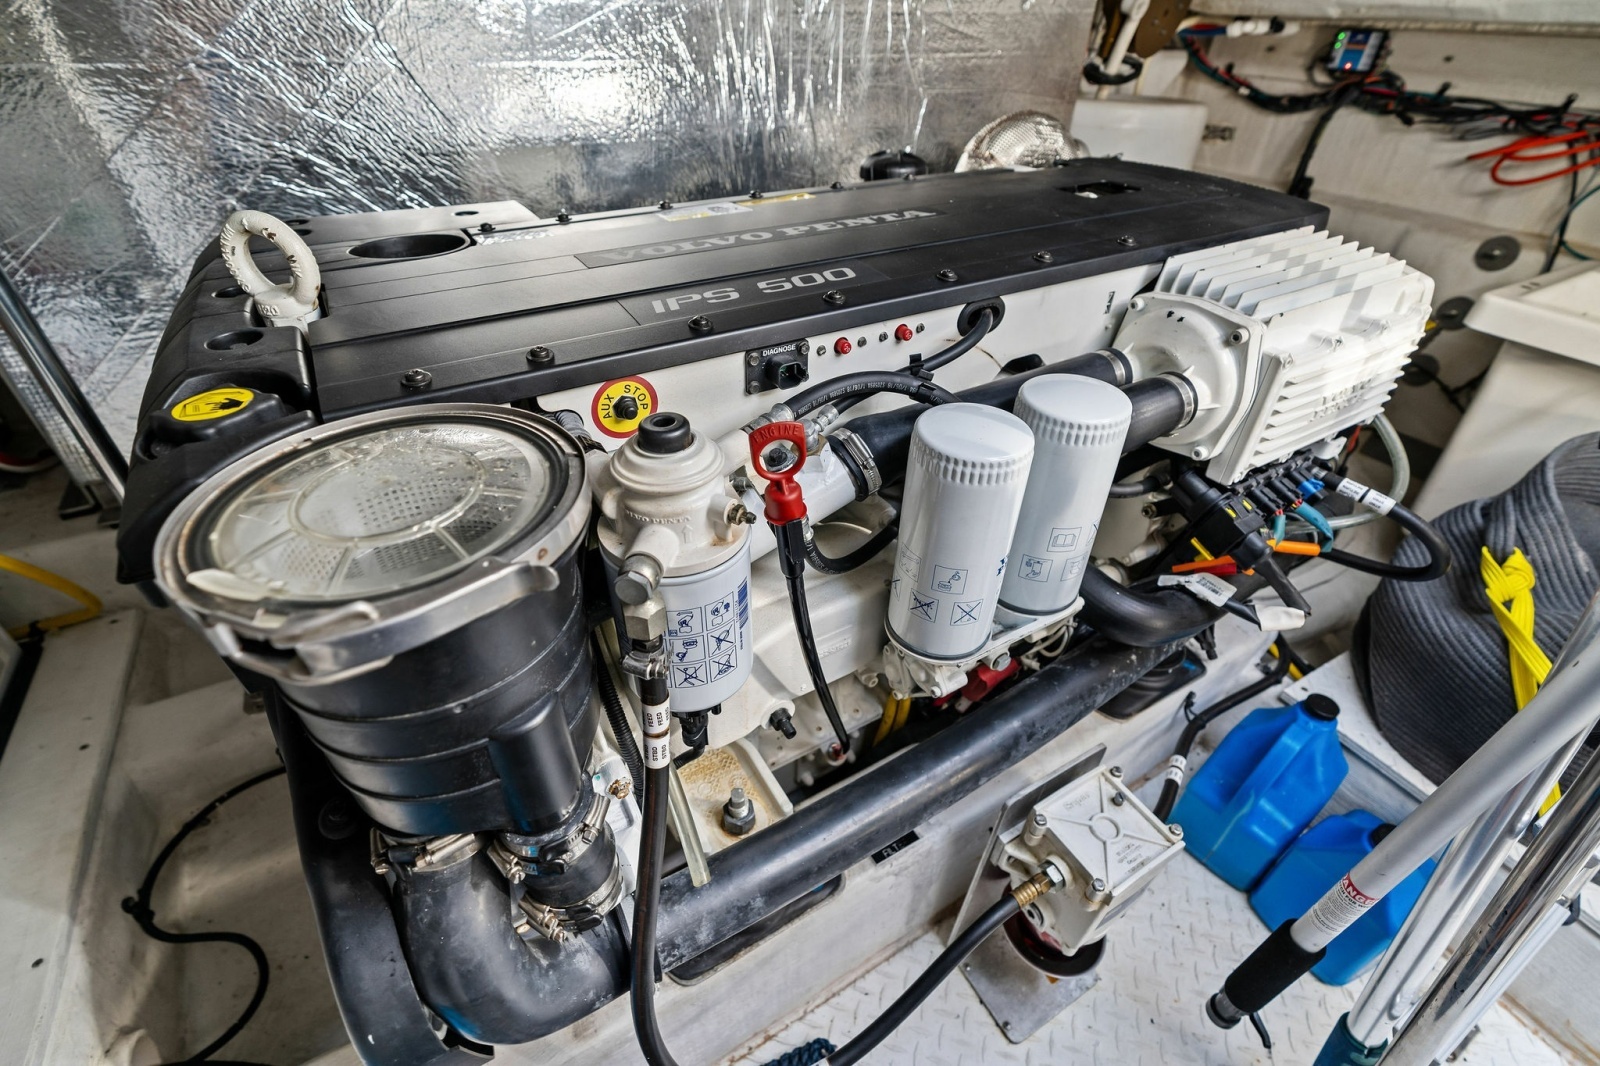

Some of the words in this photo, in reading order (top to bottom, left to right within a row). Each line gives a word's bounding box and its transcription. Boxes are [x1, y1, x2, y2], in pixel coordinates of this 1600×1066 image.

[594, 231, 773, 260] VOLVO
[777, 210, 936, 236] PENTA
[651, 287, 740, 314] IPS
[756, 267, 857, 293] 500
[762, 344, 796, 357] DIAGNOSE
[600, 393, 615, 419] AUX
[623, 384, 649, 410] STOP
[752, 424, 801, 443] ENGINE
[646, 712, 654, 728] FEED
[656, 711, 664, 727] FEED
[651, 746, 659, 762] STBD
[1341, 872, 1378, 905] ANGE
